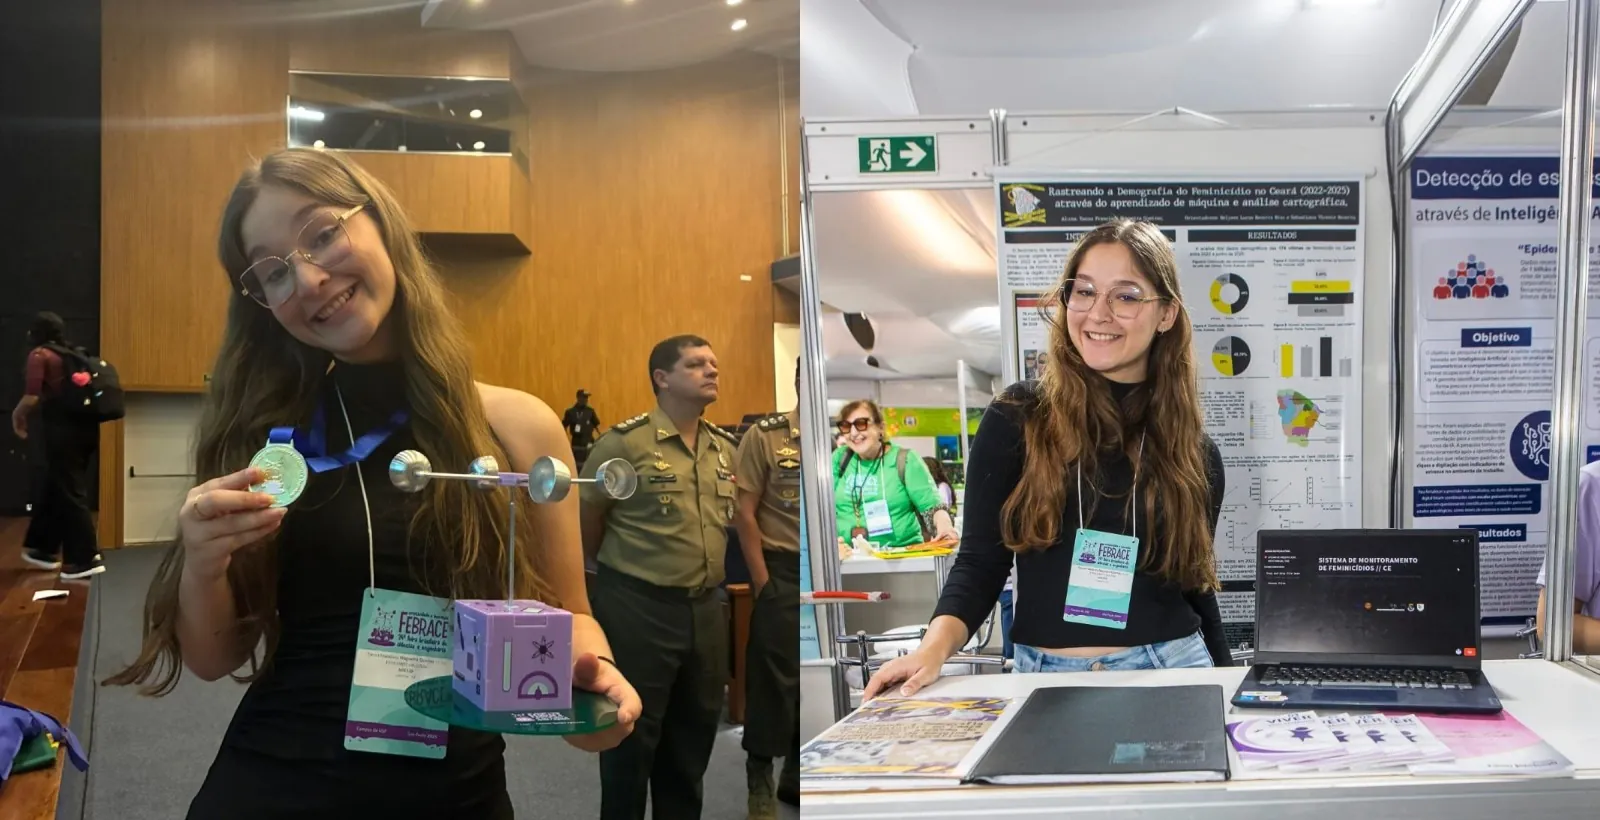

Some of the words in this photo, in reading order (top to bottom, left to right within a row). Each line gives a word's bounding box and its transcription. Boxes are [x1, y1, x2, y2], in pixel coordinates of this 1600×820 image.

[1416, 168, 1503, 191] Detecção
[1509, 168, 1532, 187] de
[1048, 186, 1104, 197] Rastreando
[1117, 186, 1173, 198] Demografia
[1176, 186, 1188, 196] do
[1192, 186, 1250, 196] Feminicídio
[1255, 188, 1266, 196] no
[1269, 186, 1296, 196] Ceará
[1300, 185, 1350, 197] (2022-2025)
[1055, 198, 1092, 208] através
[1095, 198, 1107, 208] do
[1110, 198, 1170, 210] aprendizado
[1173, 198, 1185, 207] de
[1188, 197, 1229, 209] máquina
[1242, 197, 1279, 207] análise
[1416, 205, 1469, 222] através
[1472, 205, 1491, 221] de
[1495, 205, 1560, 224] Inteligê
[1248, 231, 1298, 240] RESULTADOS
[1472, 332, 1520, 344] Objetivo
[1478, 527, 1522, 538] sultados
[1098, 542, 1131, 561] FEBRACE
[1317, 556, 1347, 565] SISTEMA
[1347, 556, 1356, 565] DE
[1357, 556, 1417, 565] MONITORAMENTO
[1317, 564, 1326, 572] DE
[1327, 563, 1374, 572] FEMINICÍDIOS
[1381, 564, 1391, 573] CE
[398, 610, 450, 639] FEBRACE
[1265, 714, 1312, 724] VIVER
